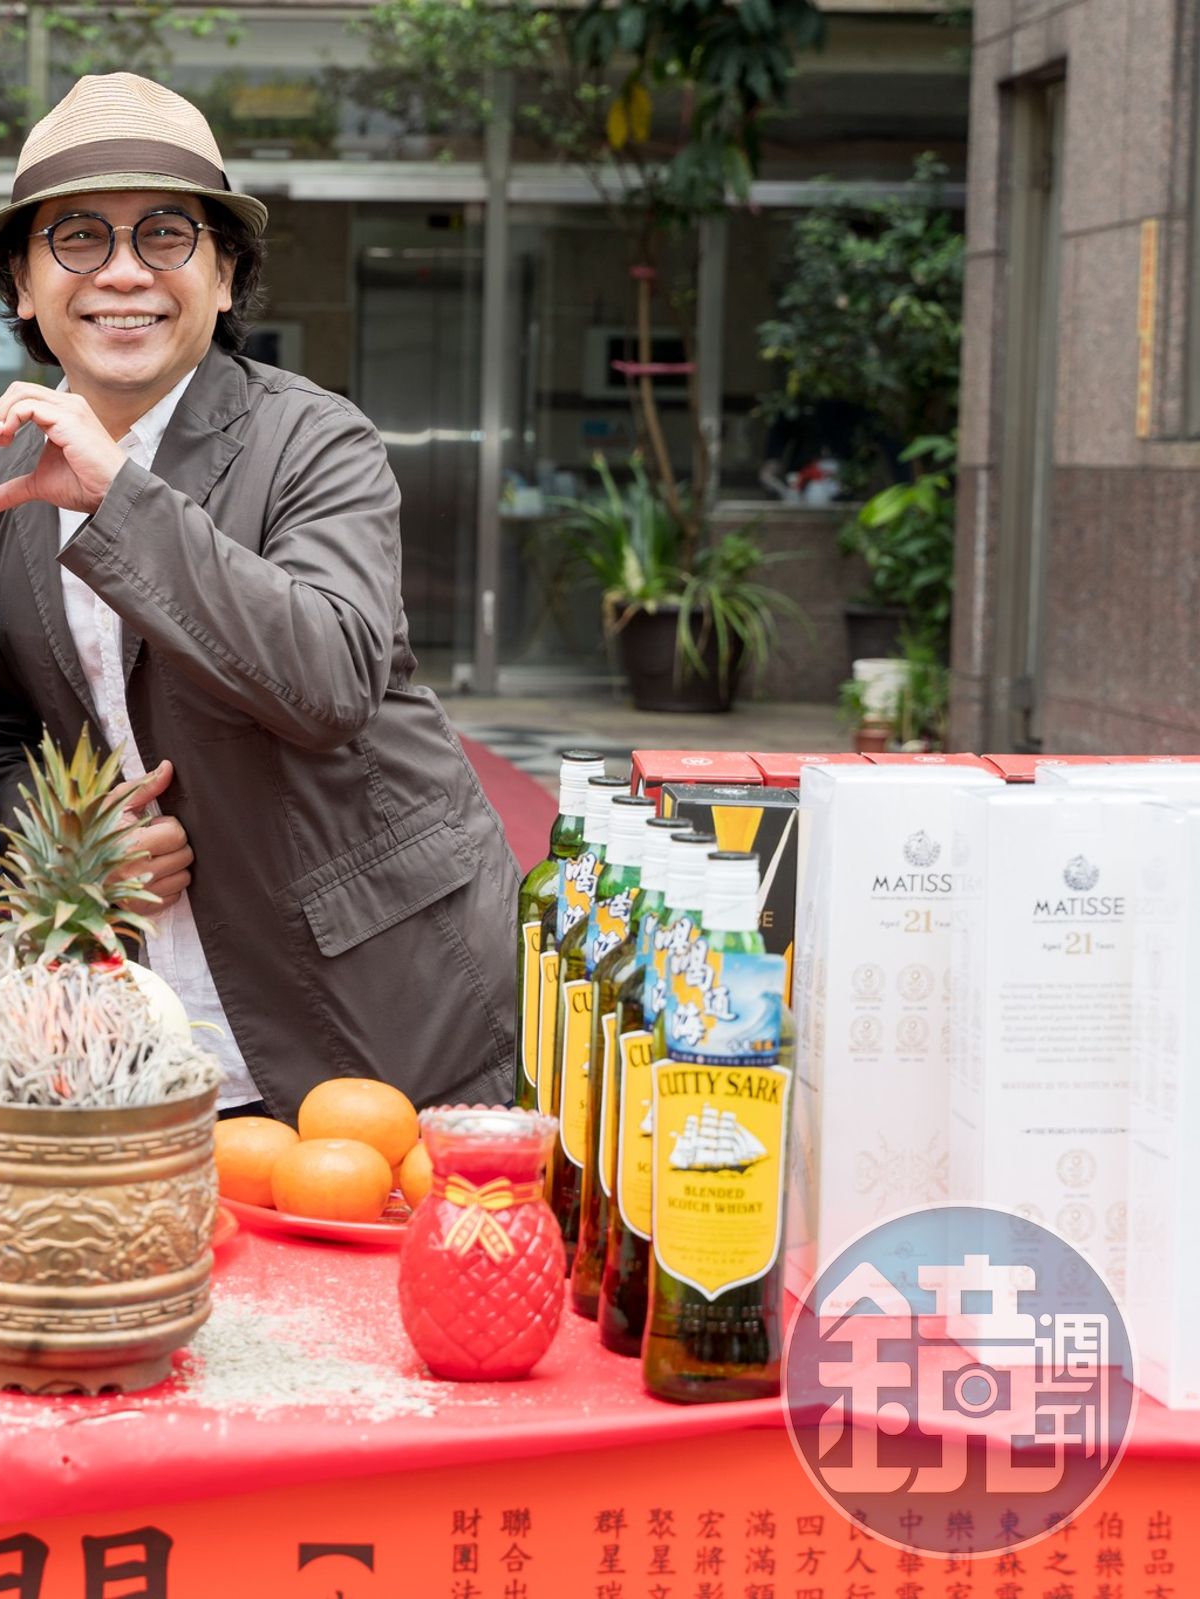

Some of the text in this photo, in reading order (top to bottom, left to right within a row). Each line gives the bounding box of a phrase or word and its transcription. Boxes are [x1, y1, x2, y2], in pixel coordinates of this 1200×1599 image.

[872, 873, 953, 893] MATISS
[1033, 896, 1126, 916] MATISSE
[903, 908, 934, 934] 21
[1064, 931, 1092, 956] 21
[658, 1070, 782, 1104] CUTTY SARK
[683, 1185, 745, 1200] BLENDED
[714, 1201, 763, 1215] WHISKY
